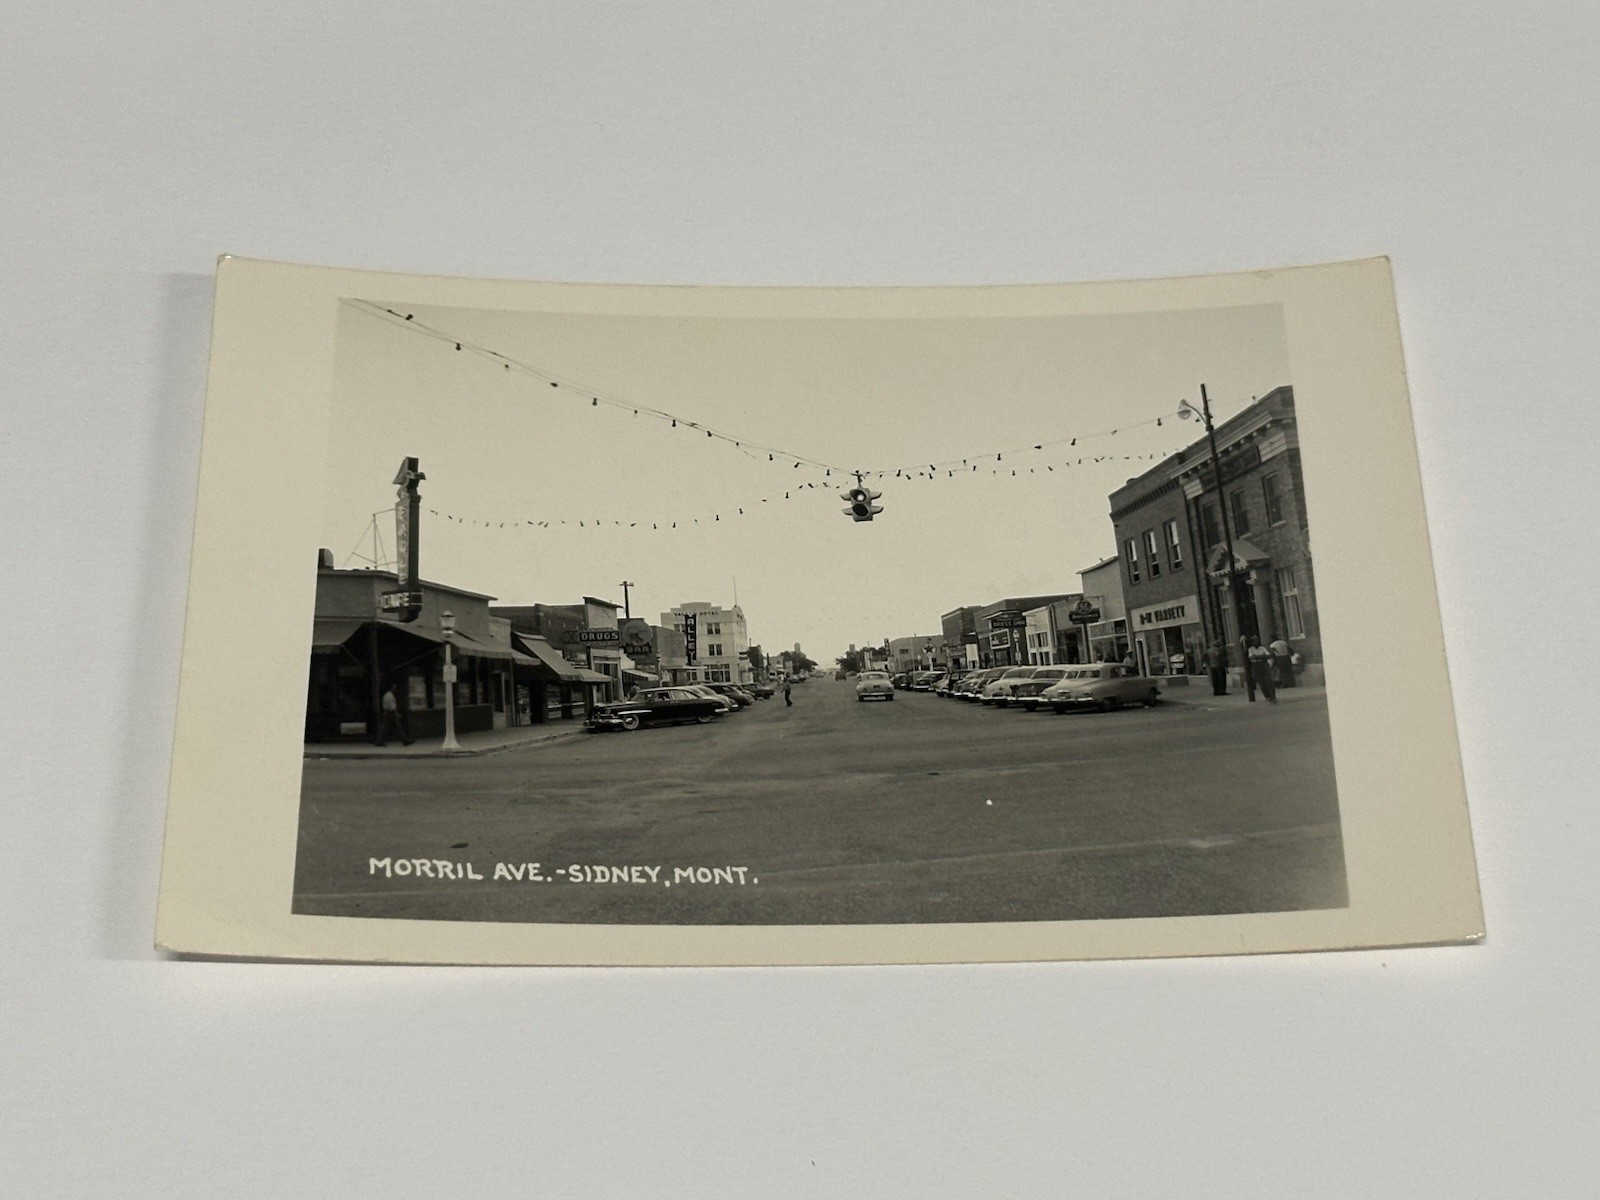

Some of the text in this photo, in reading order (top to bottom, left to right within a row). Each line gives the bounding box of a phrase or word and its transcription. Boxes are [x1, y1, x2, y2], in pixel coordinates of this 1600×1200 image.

[580, 632, 619, 641] DRUGS
[686, 611, 696, 661] VALLEY
[369, 857, 484, 881] MORRIL
